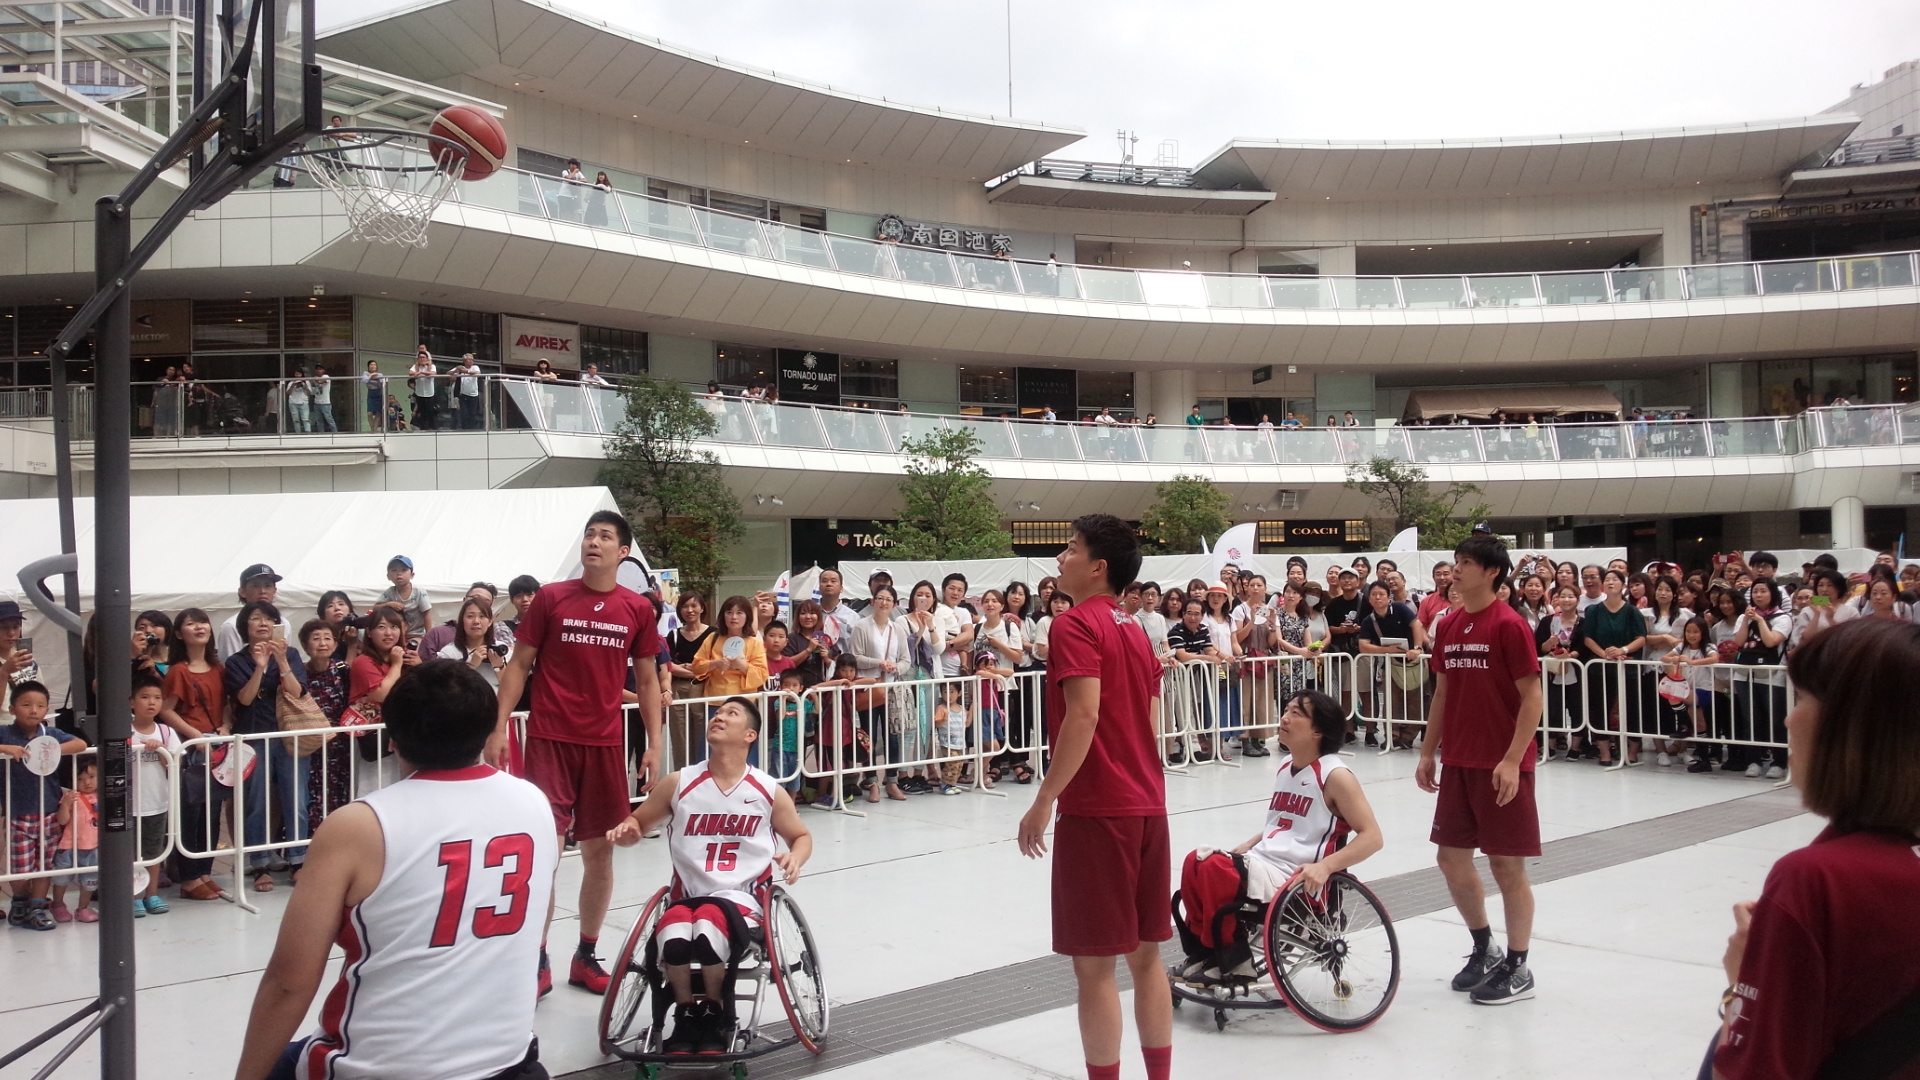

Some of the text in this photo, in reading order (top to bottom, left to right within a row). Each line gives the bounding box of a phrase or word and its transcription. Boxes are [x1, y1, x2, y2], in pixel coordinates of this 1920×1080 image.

[1749, 204, 1836, 220] california
[1841, 200, 1895, 213] PIZZA
[911, 224, 1014, 253] 南国酒家
[515, 334, 573, 352] AVIREX
[783, 369, 837, 382] TORNADO MART
[1291, 527, 1338, 535] COACH
[562, 618, 629, 634] BRAVE THUNDERS
[561, 632, 625, 649] BASKETBALL
[1444, 658, 1489, 670] BSETBALL
[683, 813, 763, 837] KAWASAKI
[1266, 817, 1293, 839] 7
[704, 841, 741, 873] 15
[428, 832, 535, 949] 13
